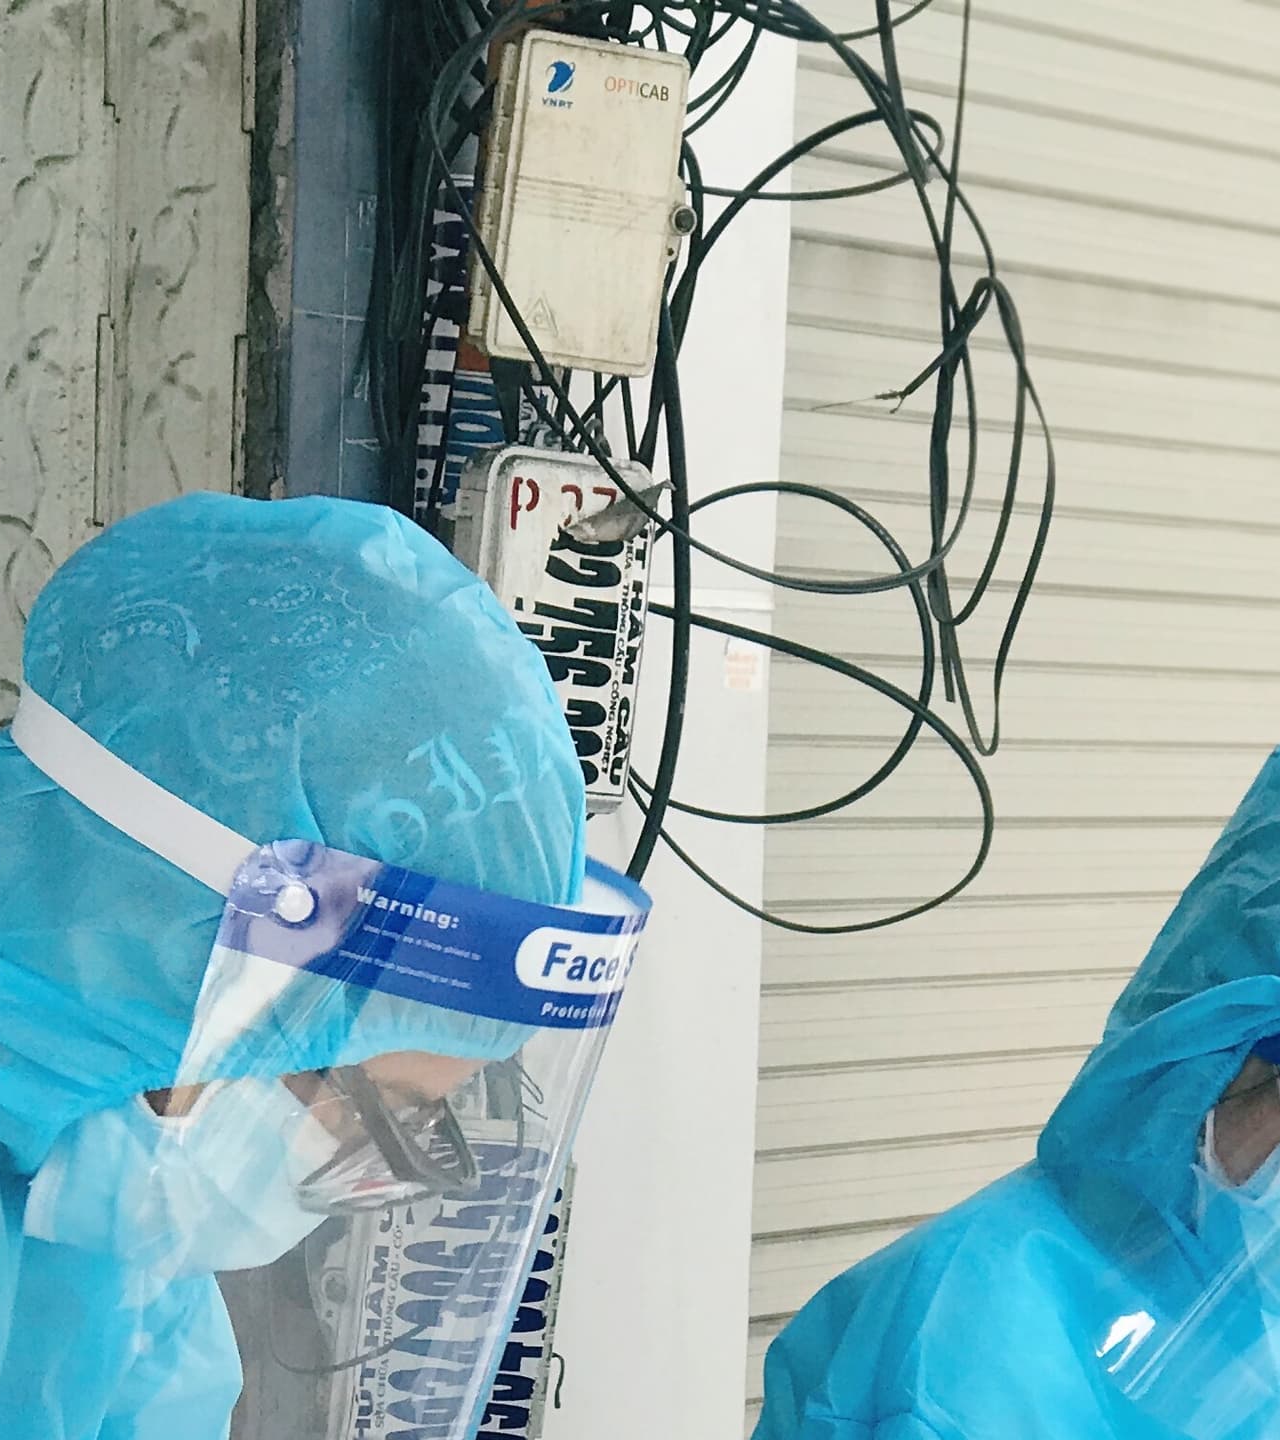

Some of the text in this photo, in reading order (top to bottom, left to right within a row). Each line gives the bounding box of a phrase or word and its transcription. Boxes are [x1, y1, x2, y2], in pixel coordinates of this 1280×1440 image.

[604, 77, 670, 102] OPTICAB
[357, 886, 460, 929] Warning:
[541, 941, 619, 983] Face
